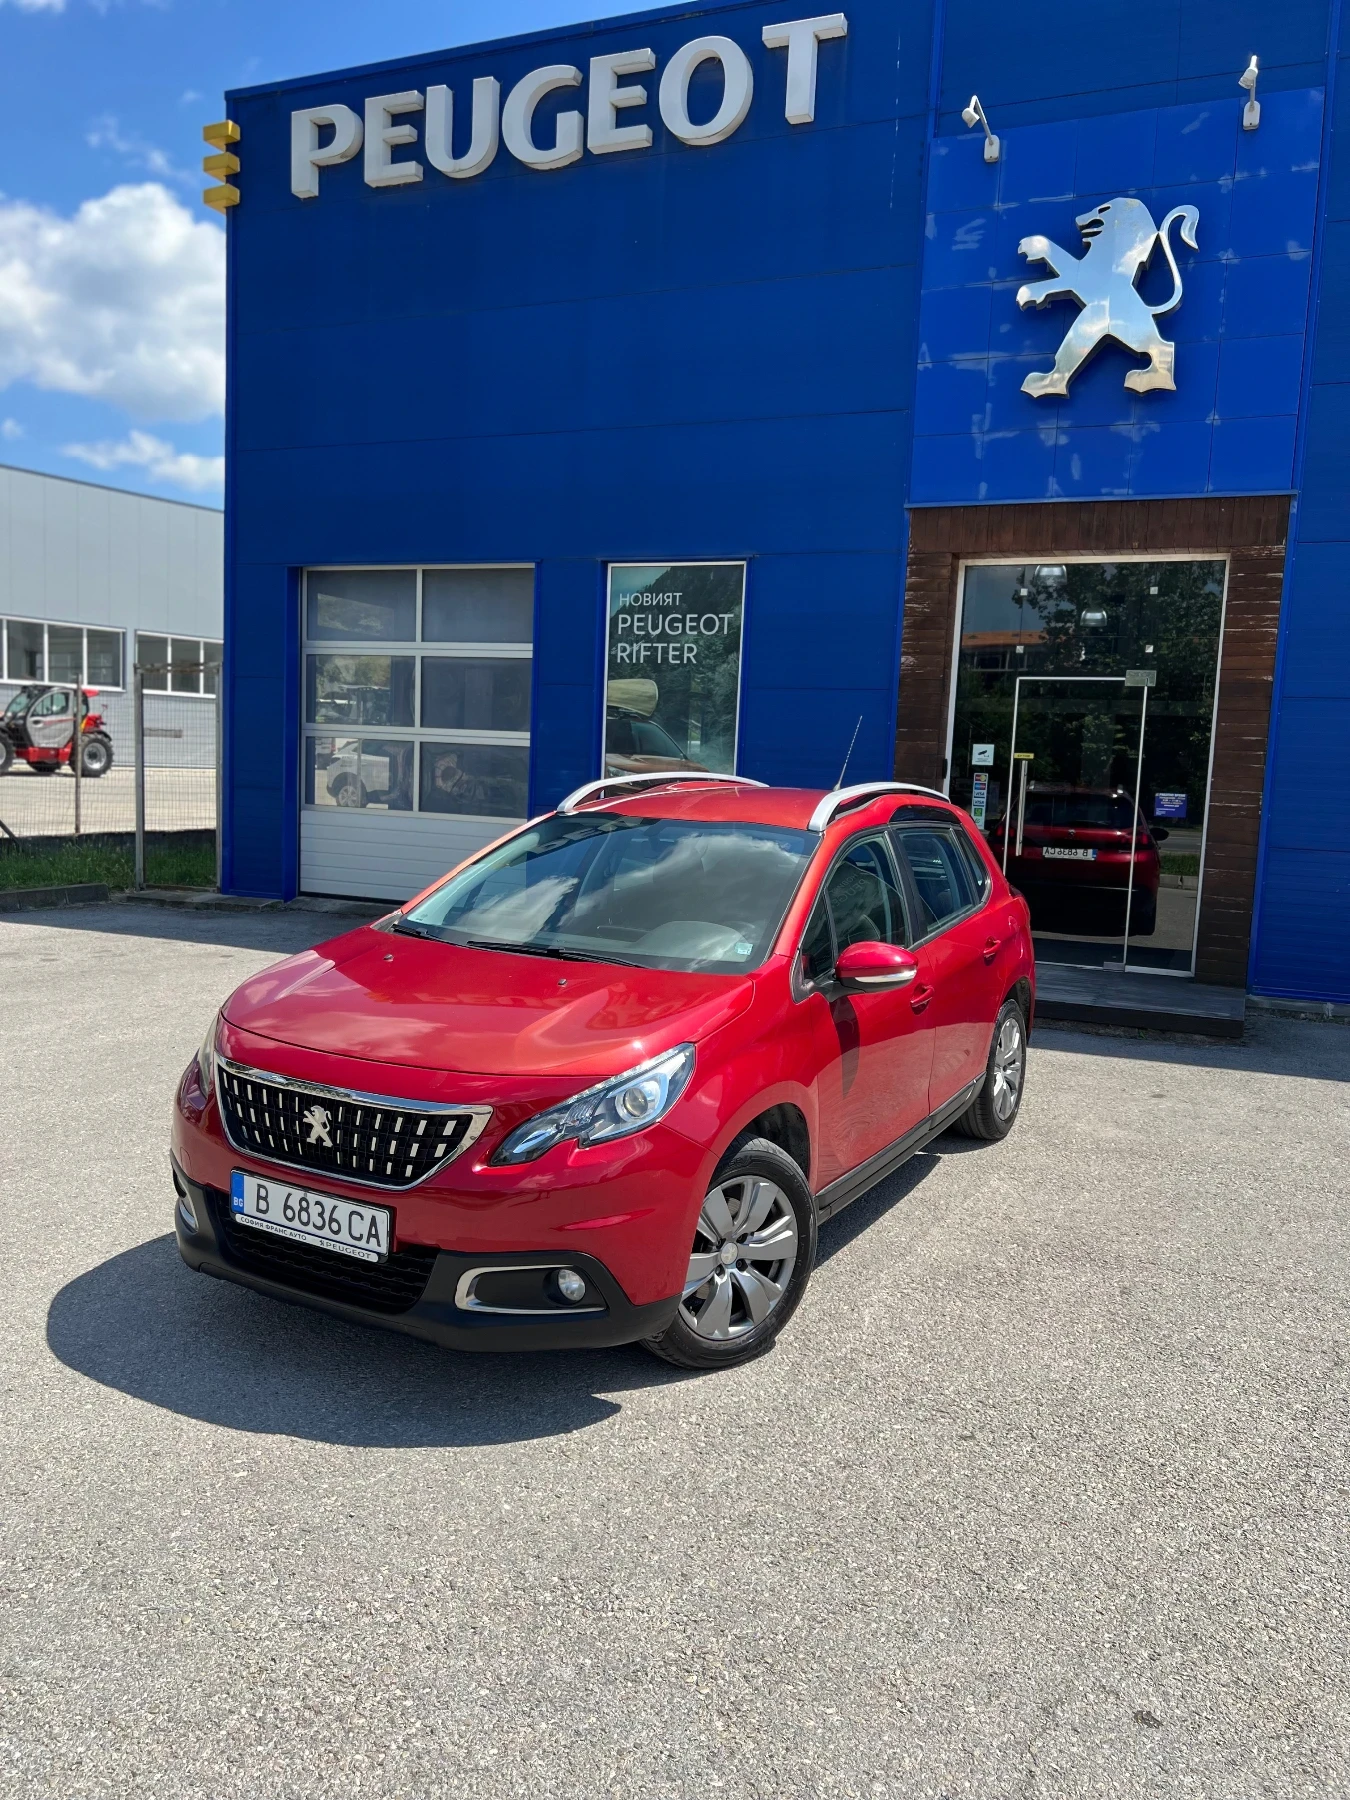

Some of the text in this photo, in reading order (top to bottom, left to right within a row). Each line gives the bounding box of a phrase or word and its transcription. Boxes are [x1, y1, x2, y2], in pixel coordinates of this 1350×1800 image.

[290, 13, 848, 199] PEUGEOT
[619, 592, 683, 606] НОВИЯТ
[617, 613, 735, 635] PEUGEOT
[616, 643, 698, 664] RIFTER
[233, 1196, 244, 1207] BG
[255, 1183, 382, 1248] B 6836 CA
[240, 1216, 307, 1241] СОФИЯ ФРАНС АУТО
[325, 1240, 372, 1260] PEUGEOT
